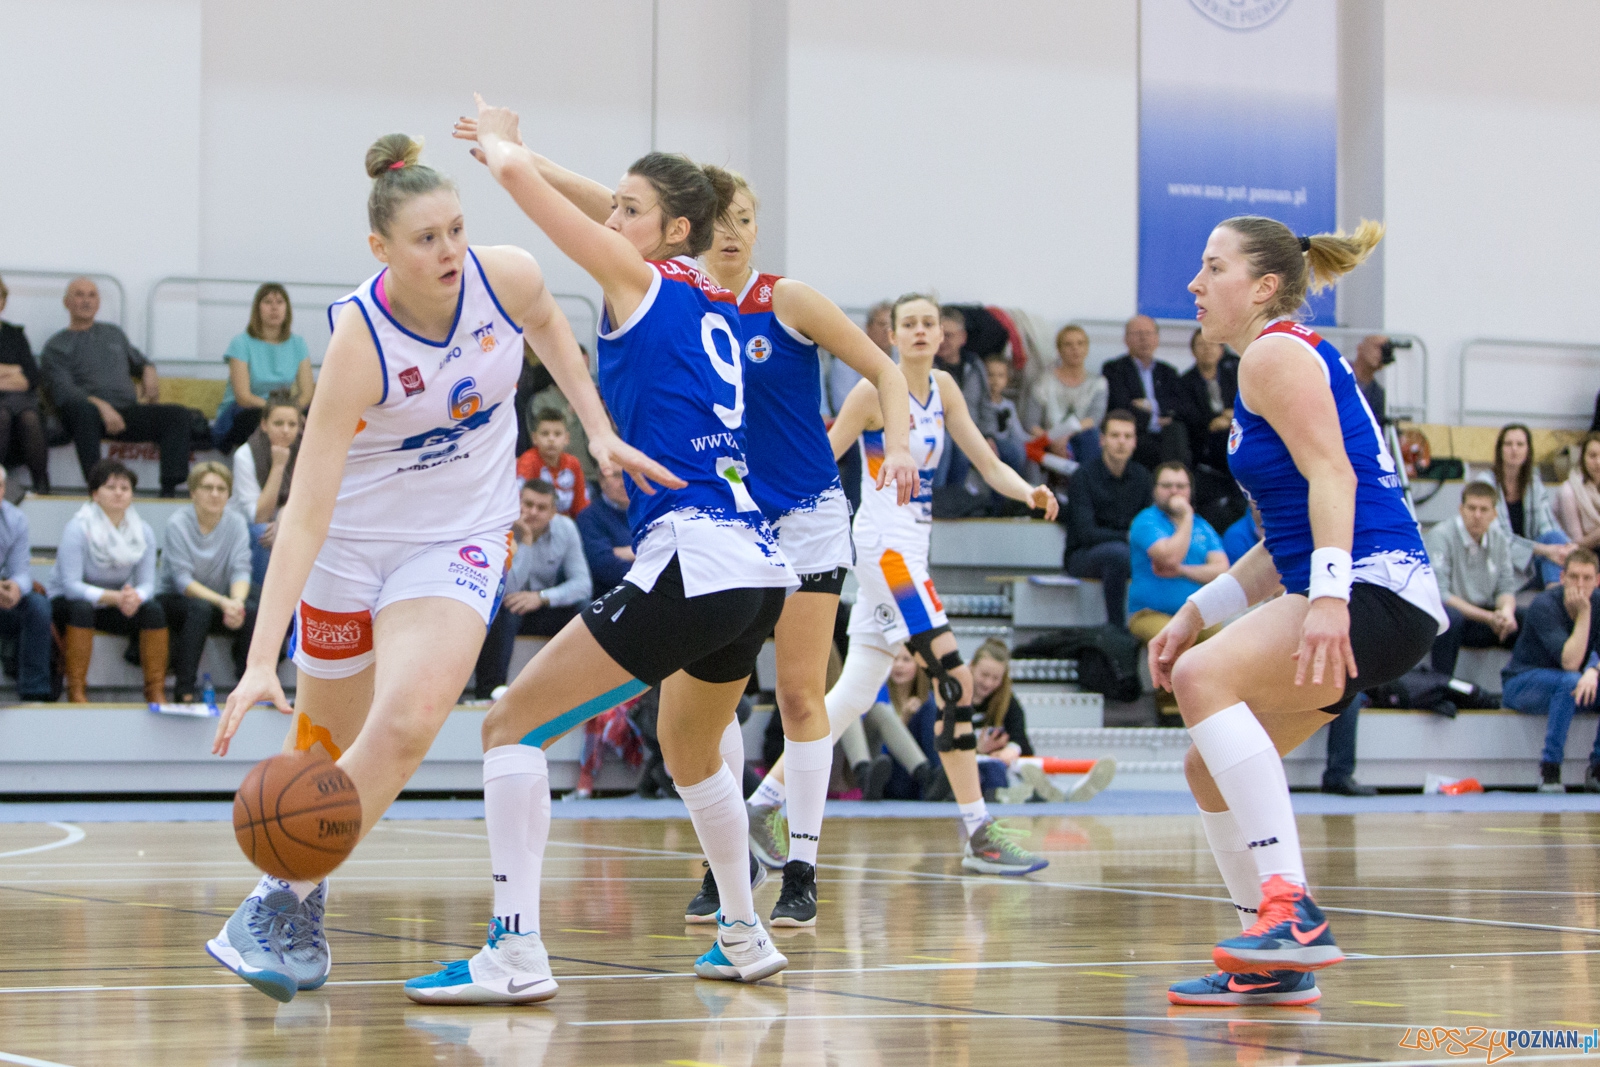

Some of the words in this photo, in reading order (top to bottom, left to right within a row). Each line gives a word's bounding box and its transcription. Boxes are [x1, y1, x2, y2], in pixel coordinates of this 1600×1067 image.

[701, 312, 744, 430] 9
[447, 376, 483, 421] 6
[923, 437, 937, 468] 7
[306, 625, 361, 643] SZPIKU
